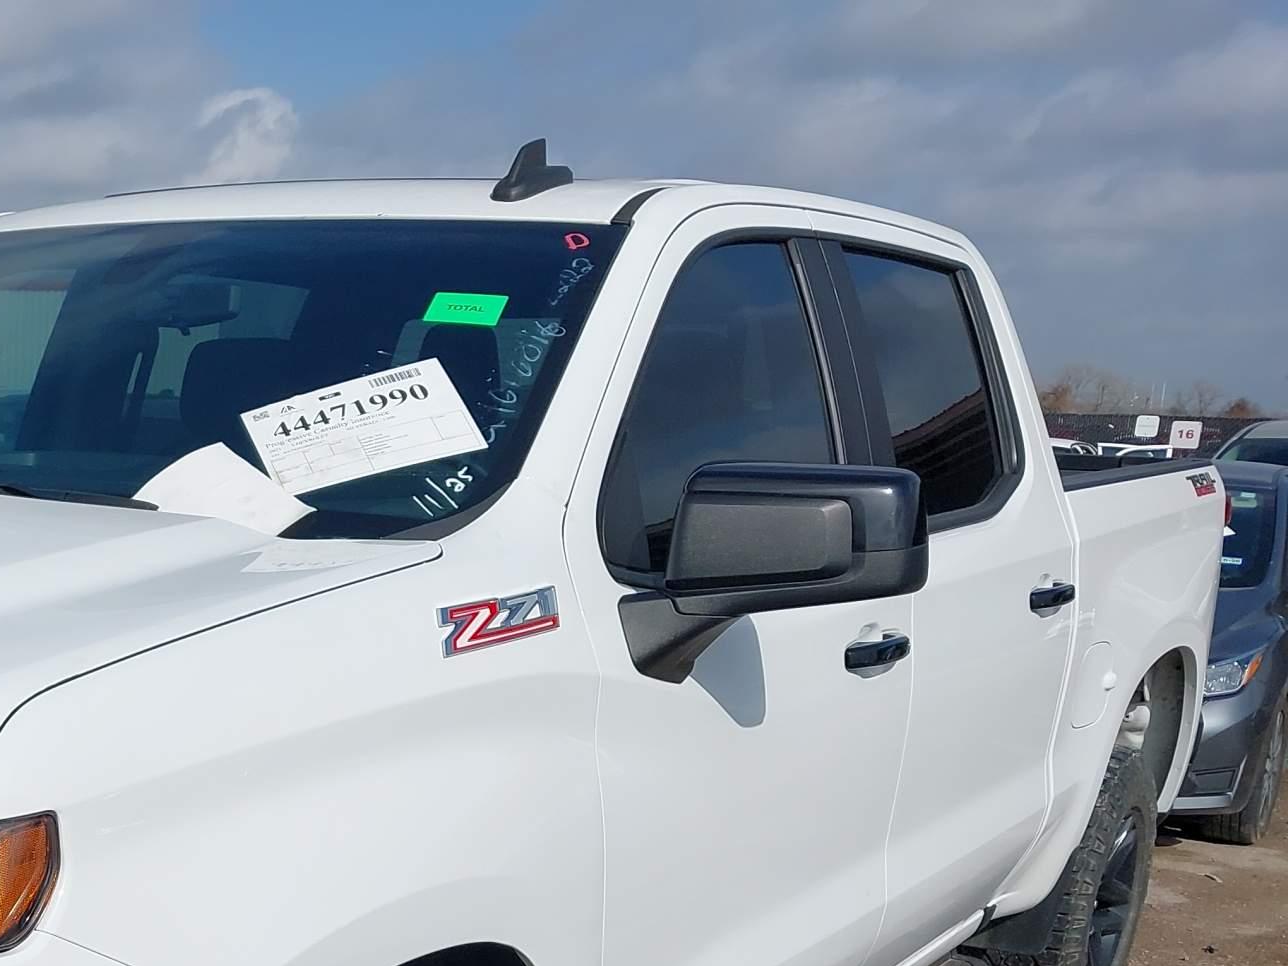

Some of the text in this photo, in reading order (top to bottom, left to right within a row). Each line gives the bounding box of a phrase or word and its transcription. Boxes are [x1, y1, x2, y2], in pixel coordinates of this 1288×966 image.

[447, 304, 485, 312] TOTAL
[273, 383, 429, 437] 44471990
[1177, 429, 1194, 439] 16
[436, 585, 560, 658] Z71
